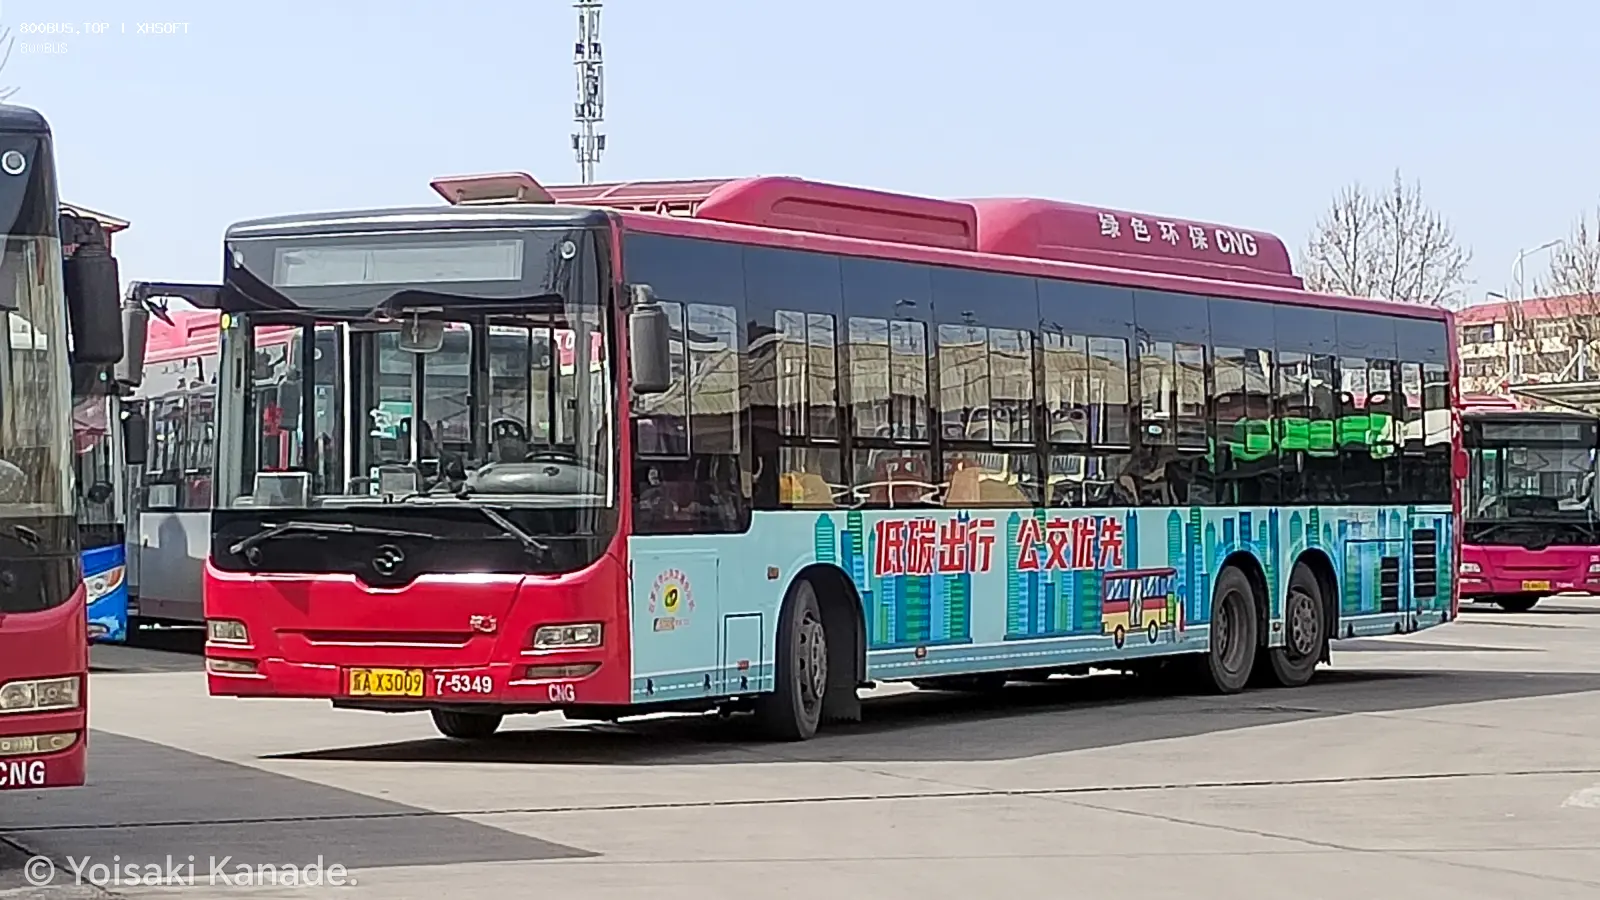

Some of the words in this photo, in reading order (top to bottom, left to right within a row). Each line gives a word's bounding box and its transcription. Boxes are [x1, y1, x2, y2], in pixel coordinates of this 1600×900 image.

[1098, 212, 1208, 250] 绿色环保
[1215, 229, 1258, 256] CNG
[874, 517, 996, 577] 低碳出行
[1016, 516, 1123, 571] 公交优先
[434, 674, 493, 695] 7-5349
[548, 683, 576, 702] CNG
